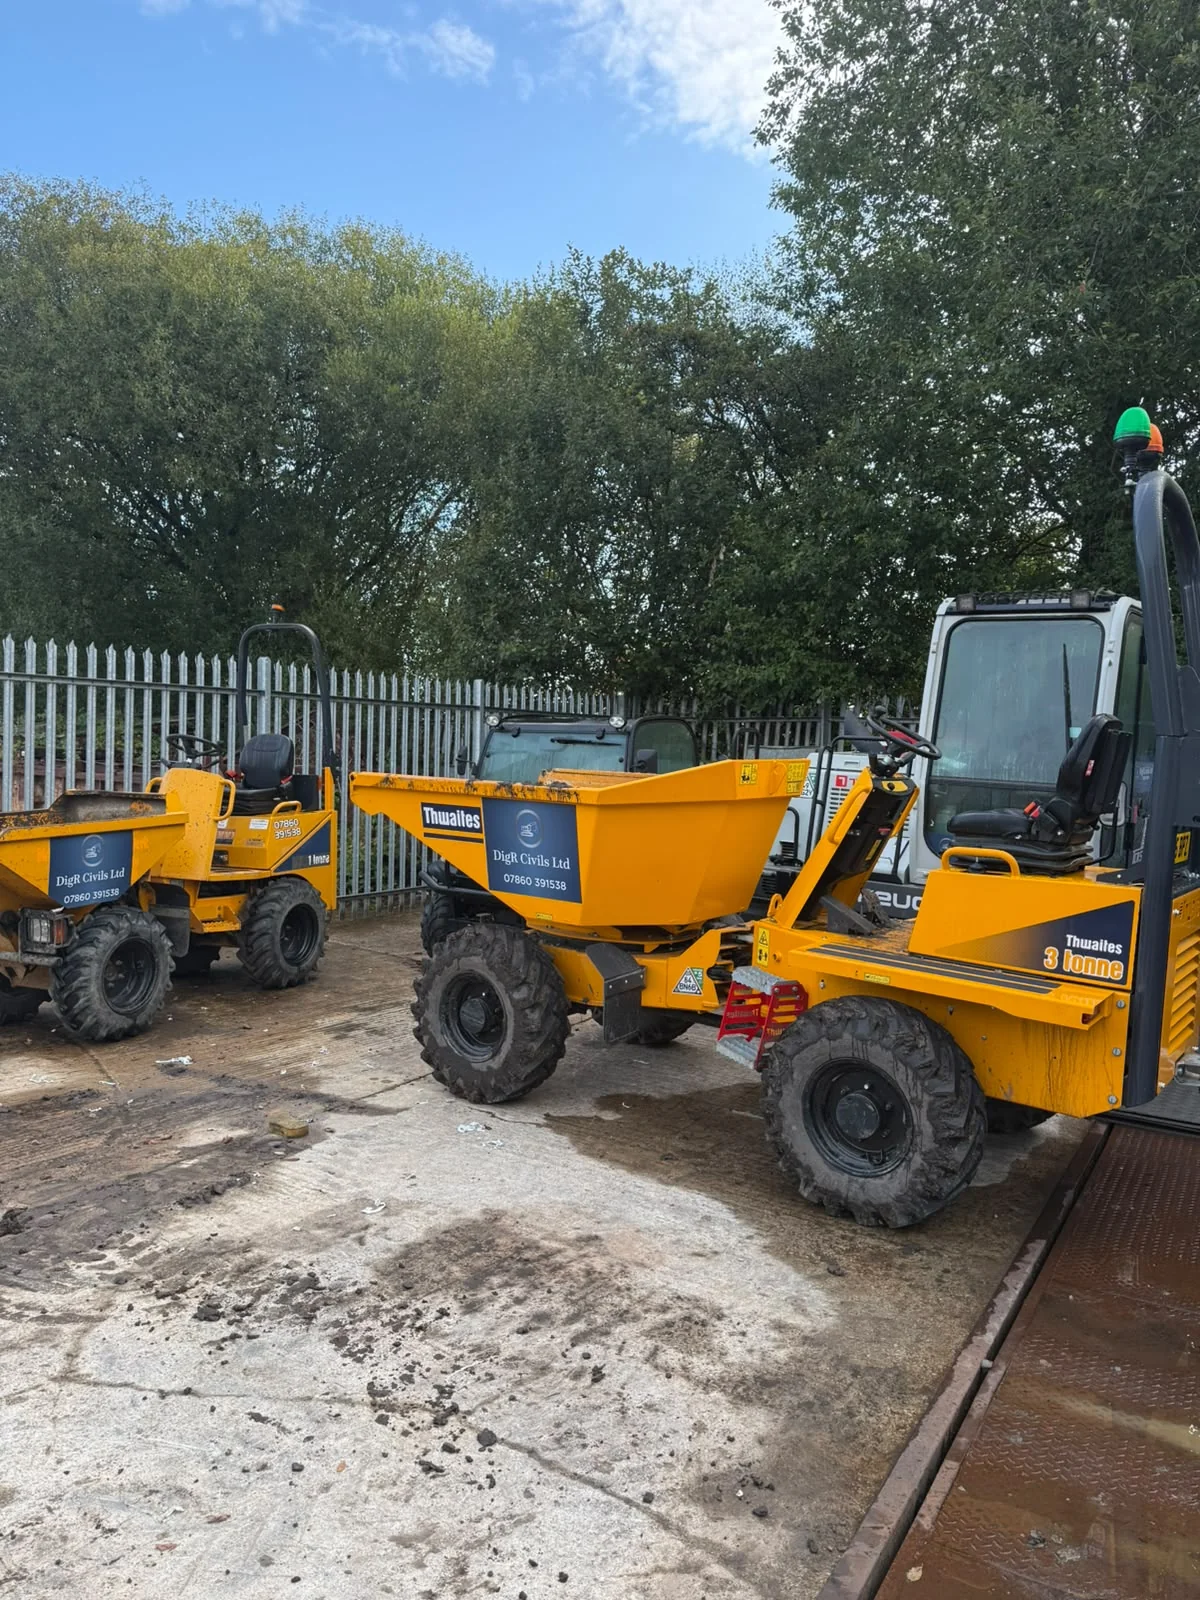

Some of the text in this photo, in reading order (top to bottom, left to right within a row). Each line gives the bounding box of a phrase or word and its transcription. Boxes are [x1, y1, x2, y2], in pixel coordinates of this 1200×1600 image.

[273, 819, 299, 829] 07860
[423, 806, 481, 829] Thwaites
[275, 827, 301, 840] 391538
[493, 849, 571, 870] DigR Civils Ltd
[56, 867, 125, 888] DigR Civils Ltd
[503, 873, 567, 891] 07860 391538
[64, 887, 120, 904] 07860 391538
[1066, 934, 1123, 955] Thwaites
[1043, 946, 1124, 980] 3 tonne
